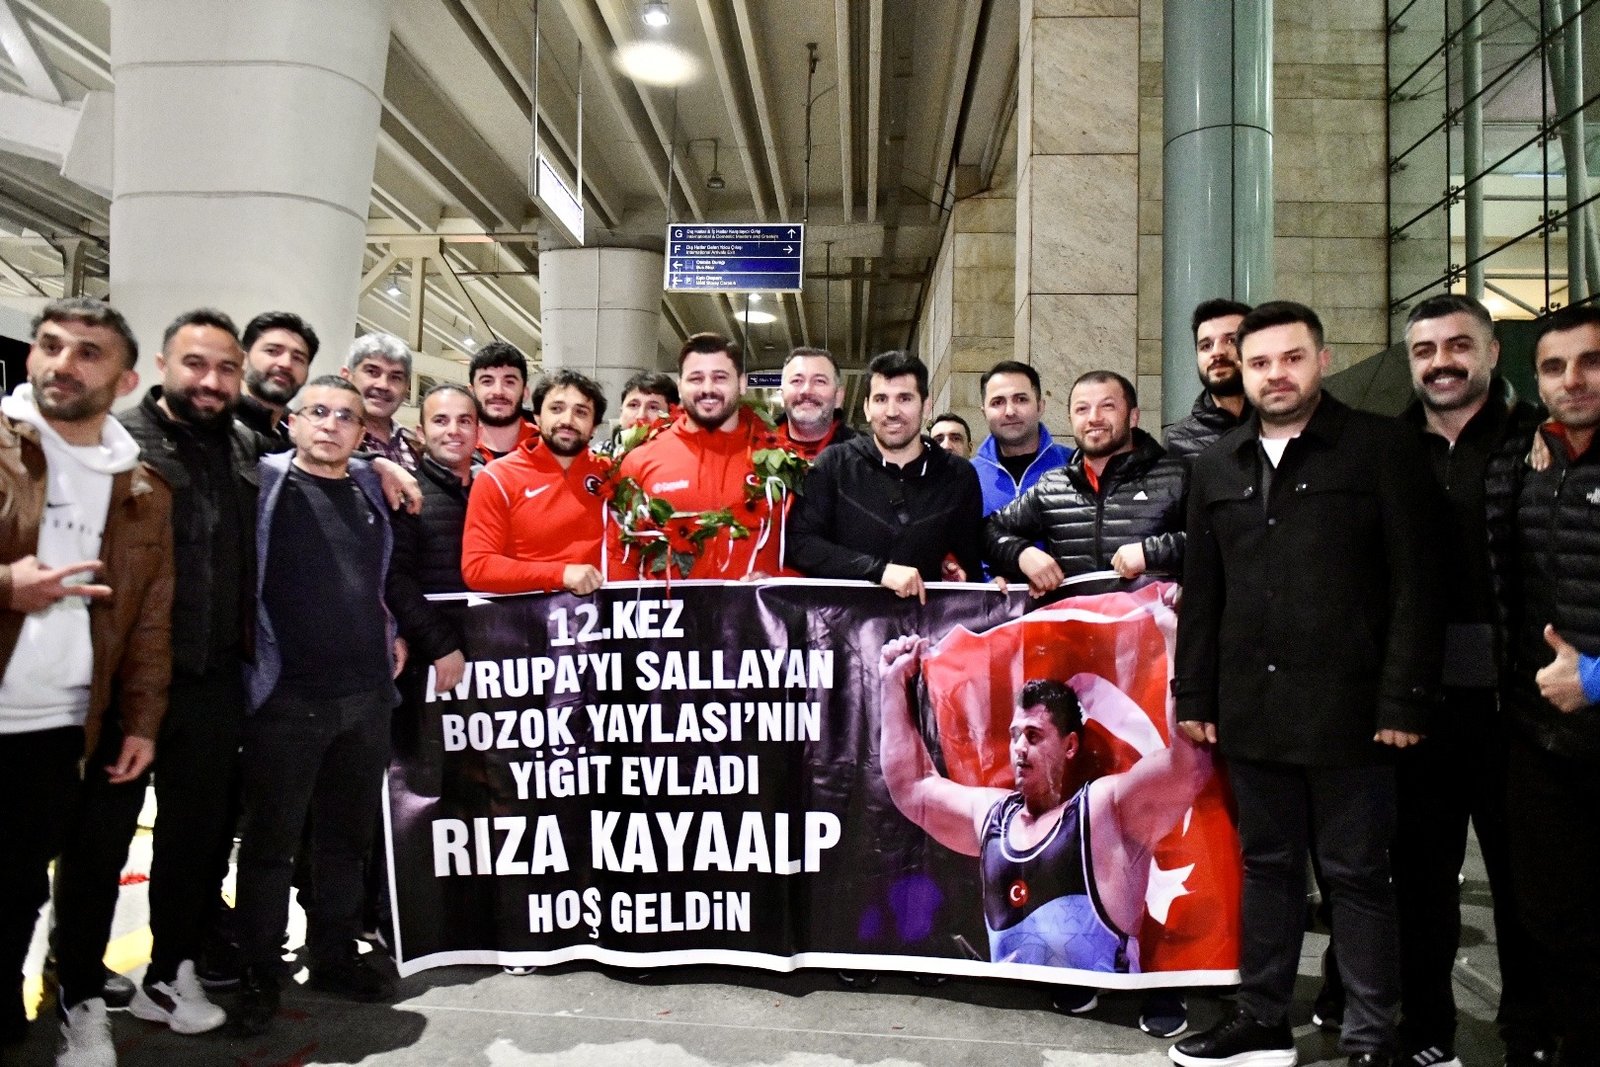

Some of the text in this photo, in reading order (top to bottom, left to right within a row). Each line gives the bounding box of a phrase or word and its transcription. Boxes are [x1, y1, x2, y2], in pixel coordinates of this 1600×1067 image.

[674, 229, 683, 238] G
[674, 245, 681, 254] F
[635, 650, 834, 692] SALLAYAN
[442, 702, 821, 752] BOZOK YAYLASI'NIN
[509, 747, 758, 800] YİĞİT EVLADI
[432, 809, 841, 878] RIZA KAYAALP
[528, 887, 602, 939] HOŞ
